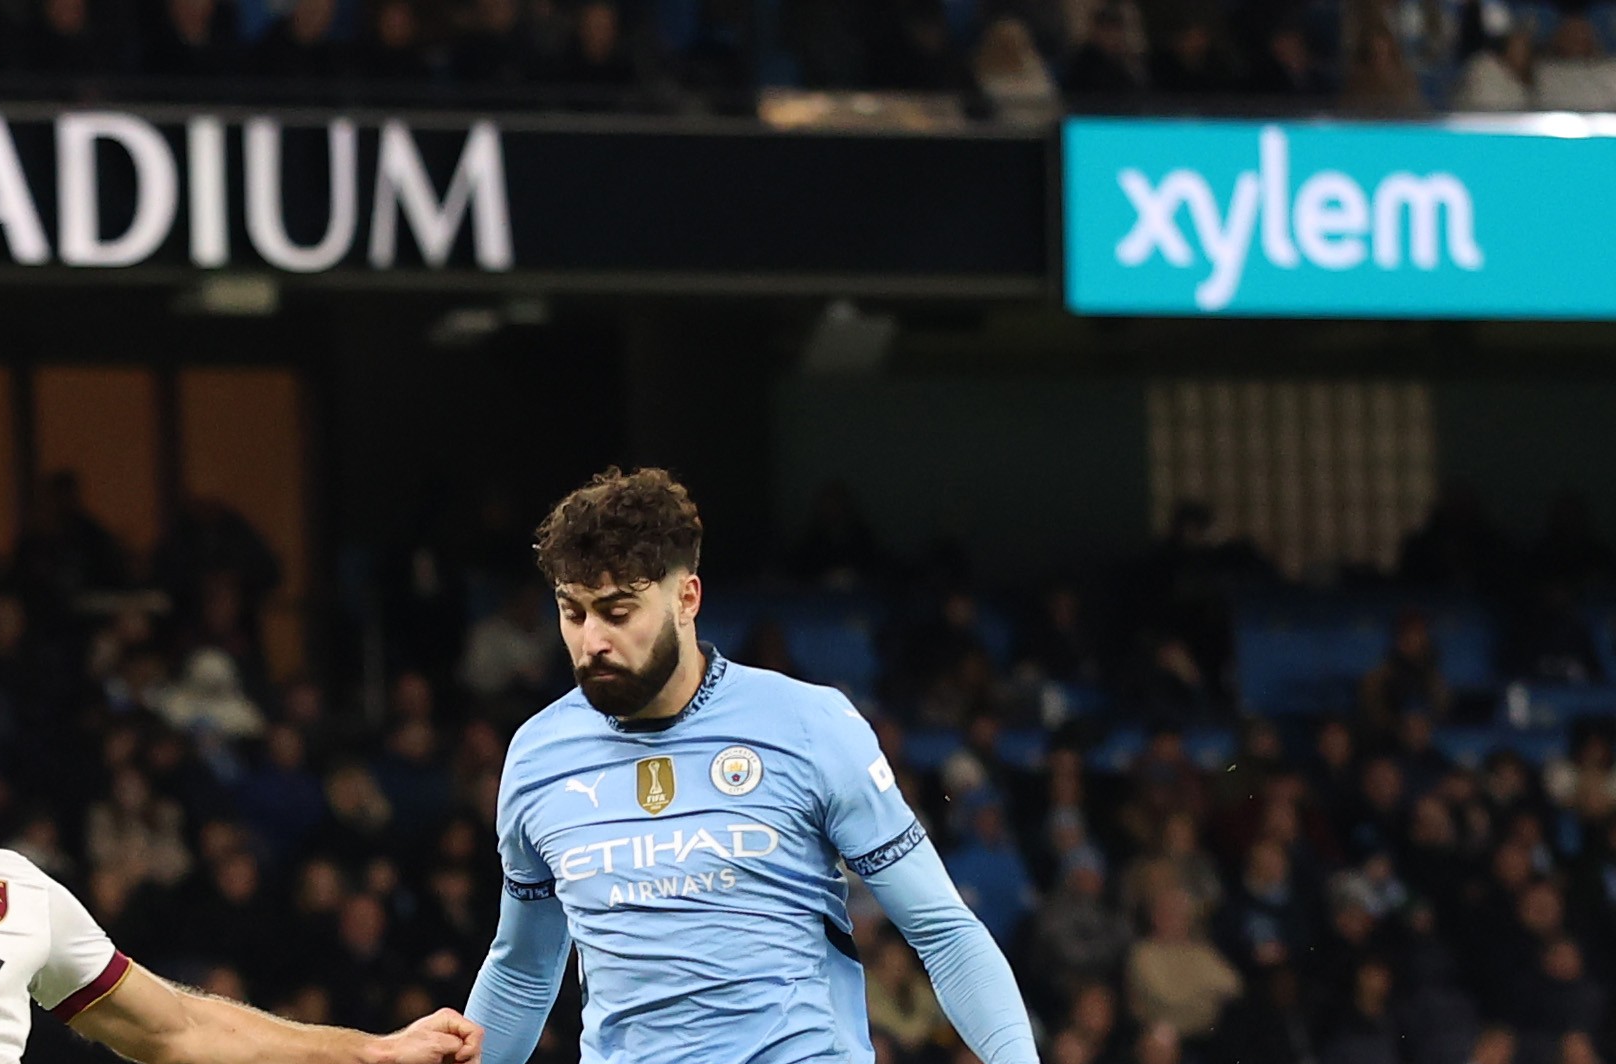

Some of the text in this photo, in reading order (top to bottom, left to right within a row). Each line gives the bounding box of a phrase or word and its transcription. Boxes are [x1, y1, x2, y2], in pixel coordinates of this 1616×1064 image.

[1115, 126, 1485, 312] xylem
[715, 749, 758, 766] MANCHESTER
[646, 794, 667, 804] FIFA
[560, 823, 780, 882] ETIHAD
[609, 868, 736, 908] AIRWAYS
